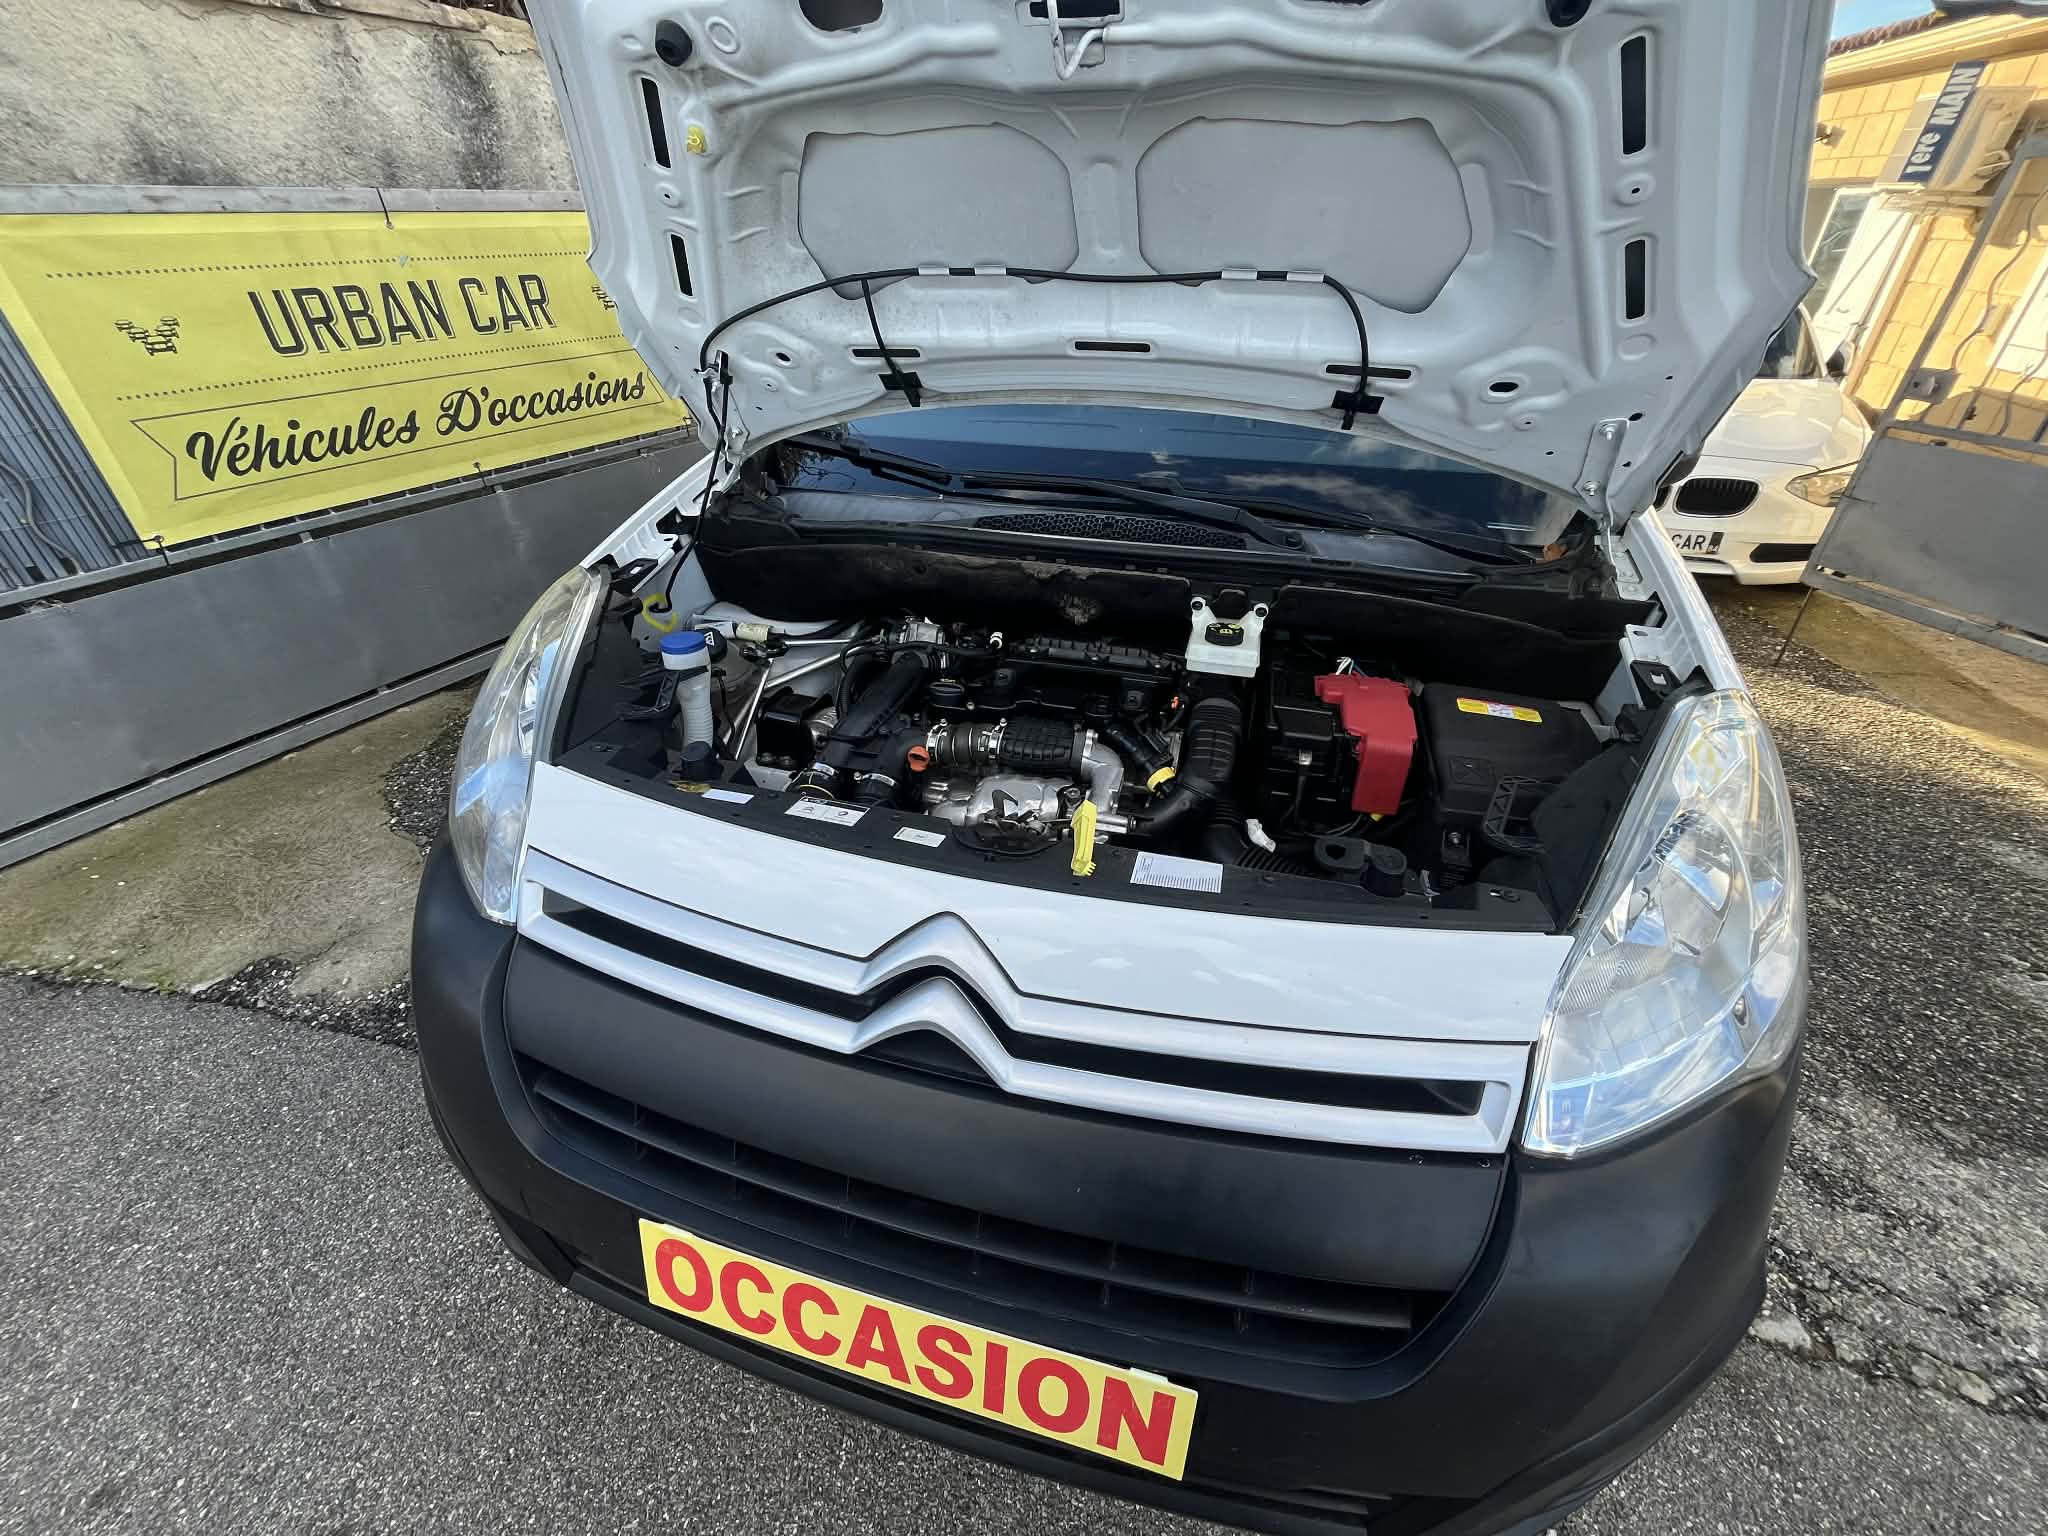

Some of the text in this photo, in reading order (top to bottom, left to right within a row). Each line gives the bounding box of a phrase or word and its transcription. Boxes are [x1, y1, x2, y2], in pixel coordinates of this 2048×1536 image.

[1930, 67, 1982, 125] MAIN
[247, 274, 557, 358] URBAN CAR
[185, 371, 646, 482] Véhicules D'occasions
[1671, 534, 1707, 550] CAR
[655, 1238, 1177, 1467] OCCASION
